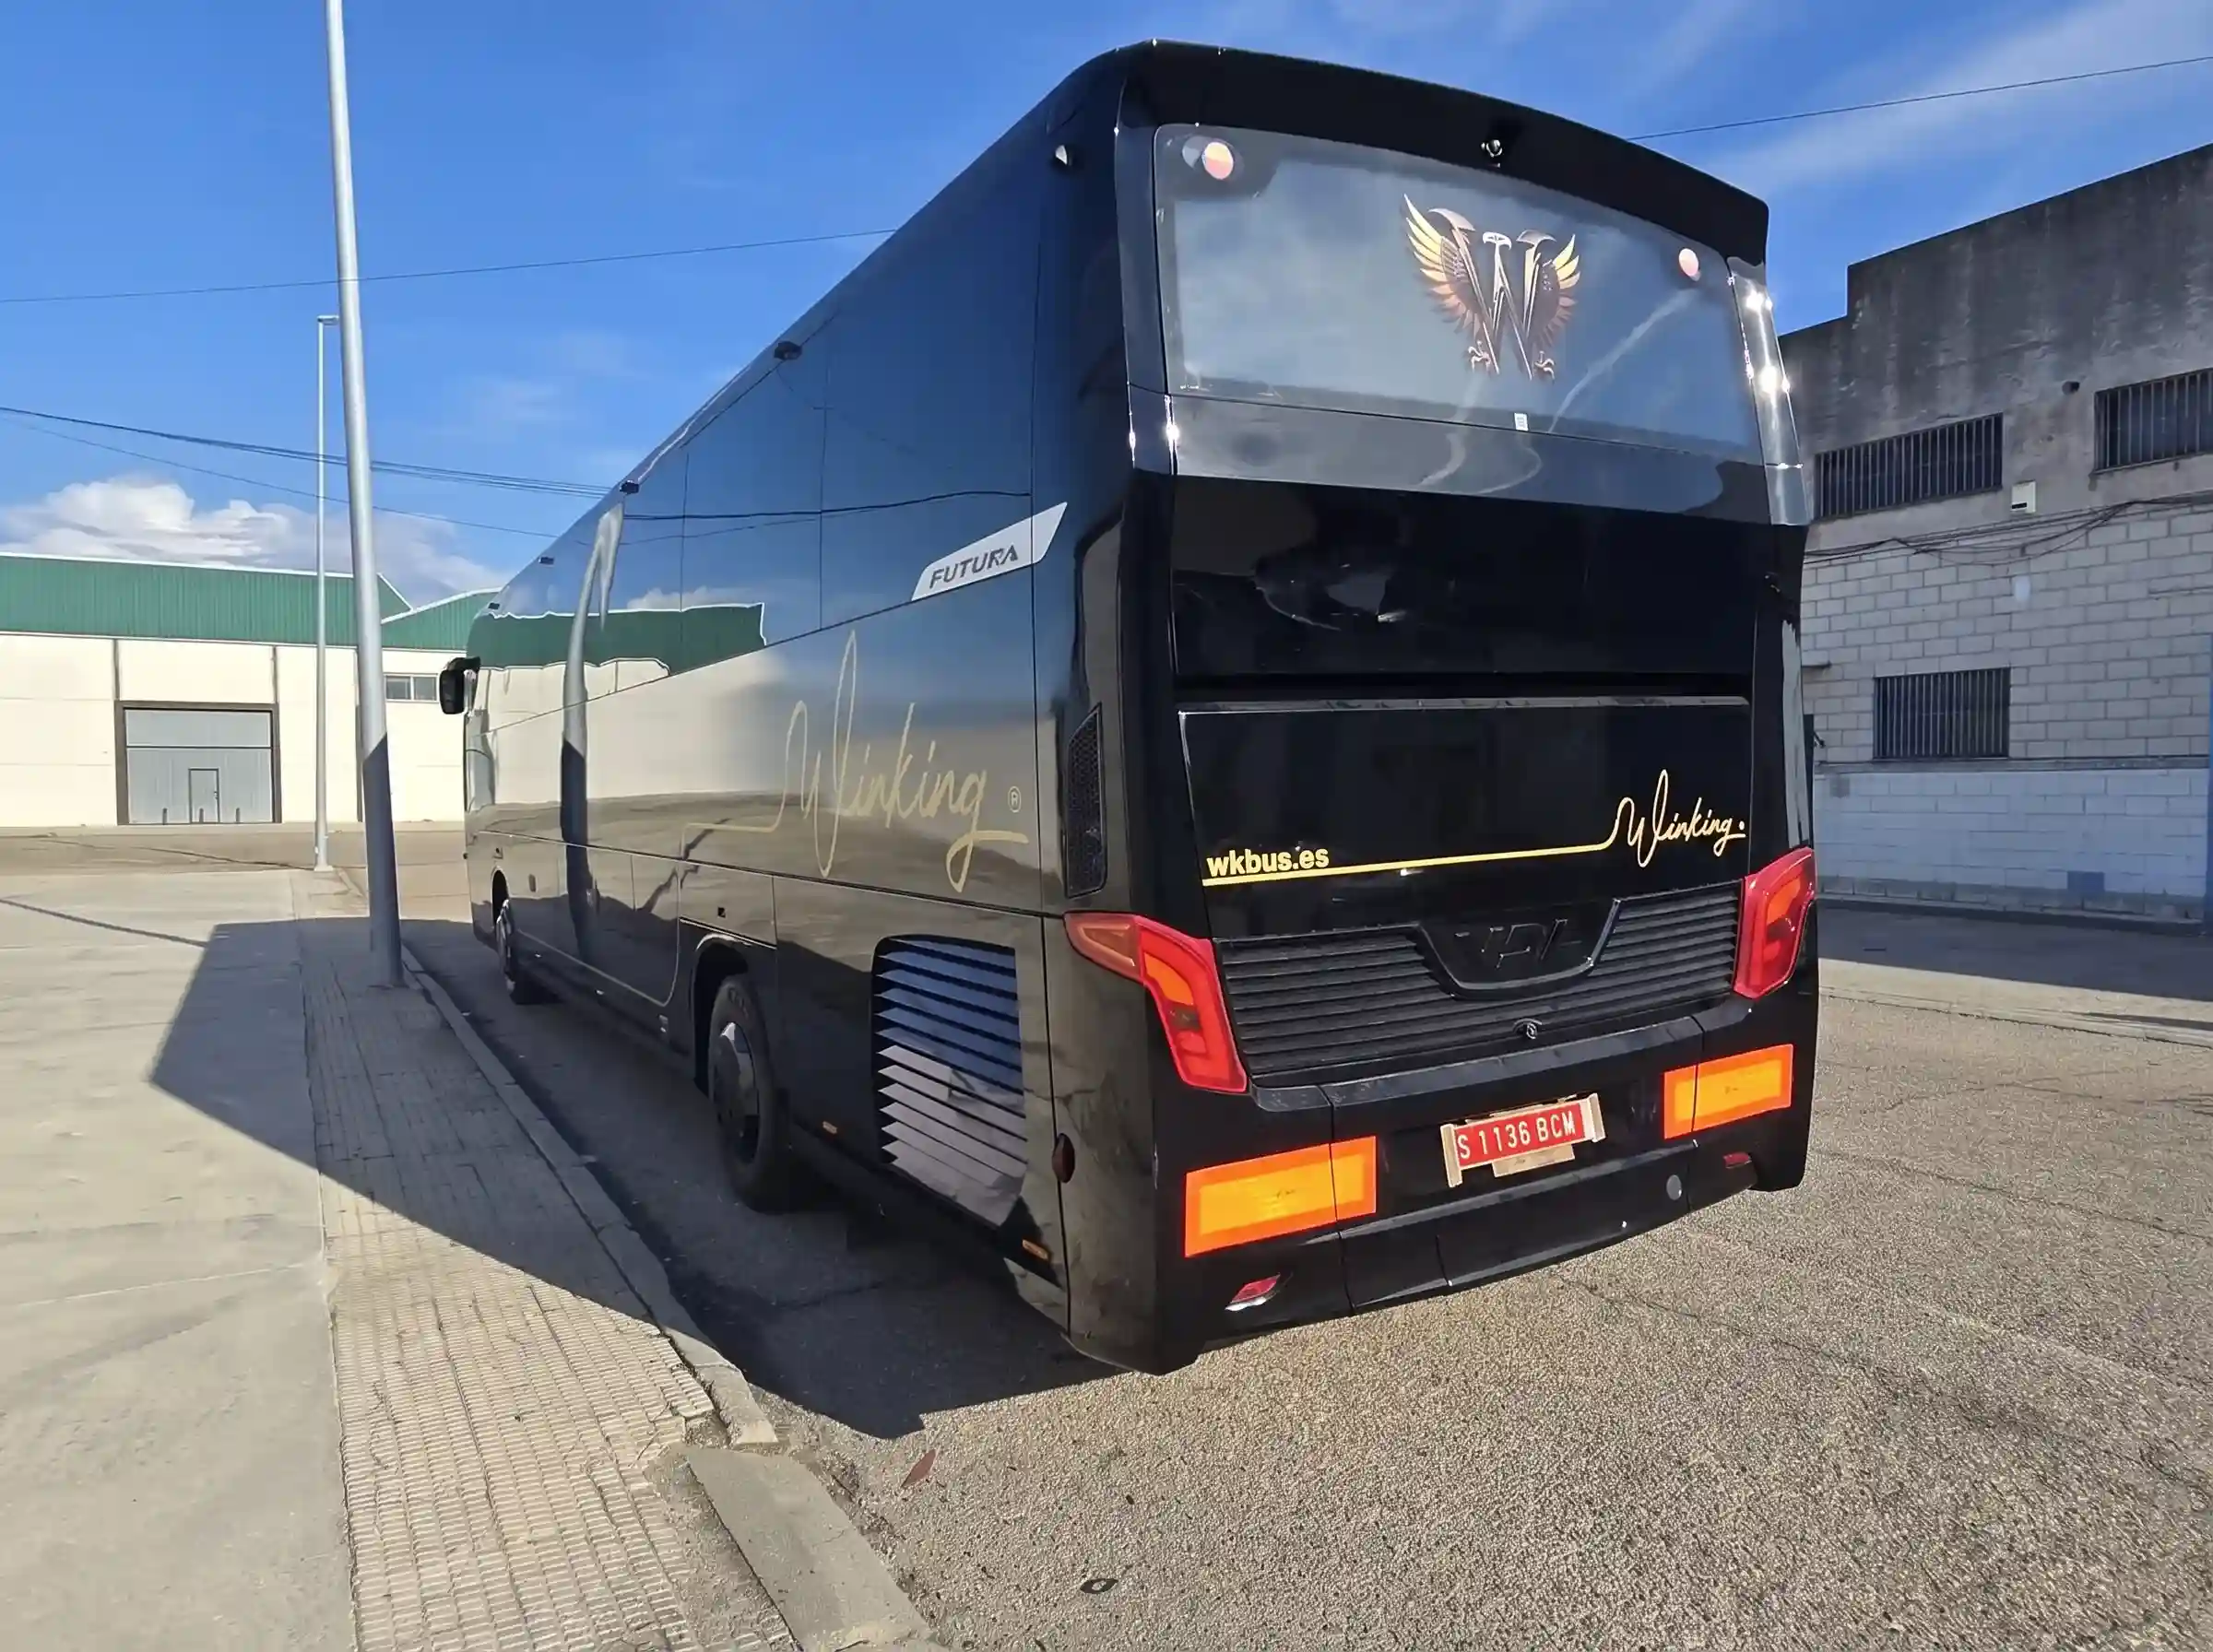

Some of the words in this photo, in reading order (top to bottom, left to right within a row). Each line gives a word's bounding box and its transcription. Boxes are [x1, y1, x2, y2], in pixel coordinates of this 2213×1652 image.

[929, 545, 1018, 589] FUTURA
[775, 630, 1028, 892] Winking
[1614, 769, 1746, 867] Winking
[1206, 848, 1329, 877] wkbus.es
[1458, 1134, 1471, 1160] S
[1479, 1121, 1531, 1155] 1136
[1535, 1110, 1576, 1142] BCM
